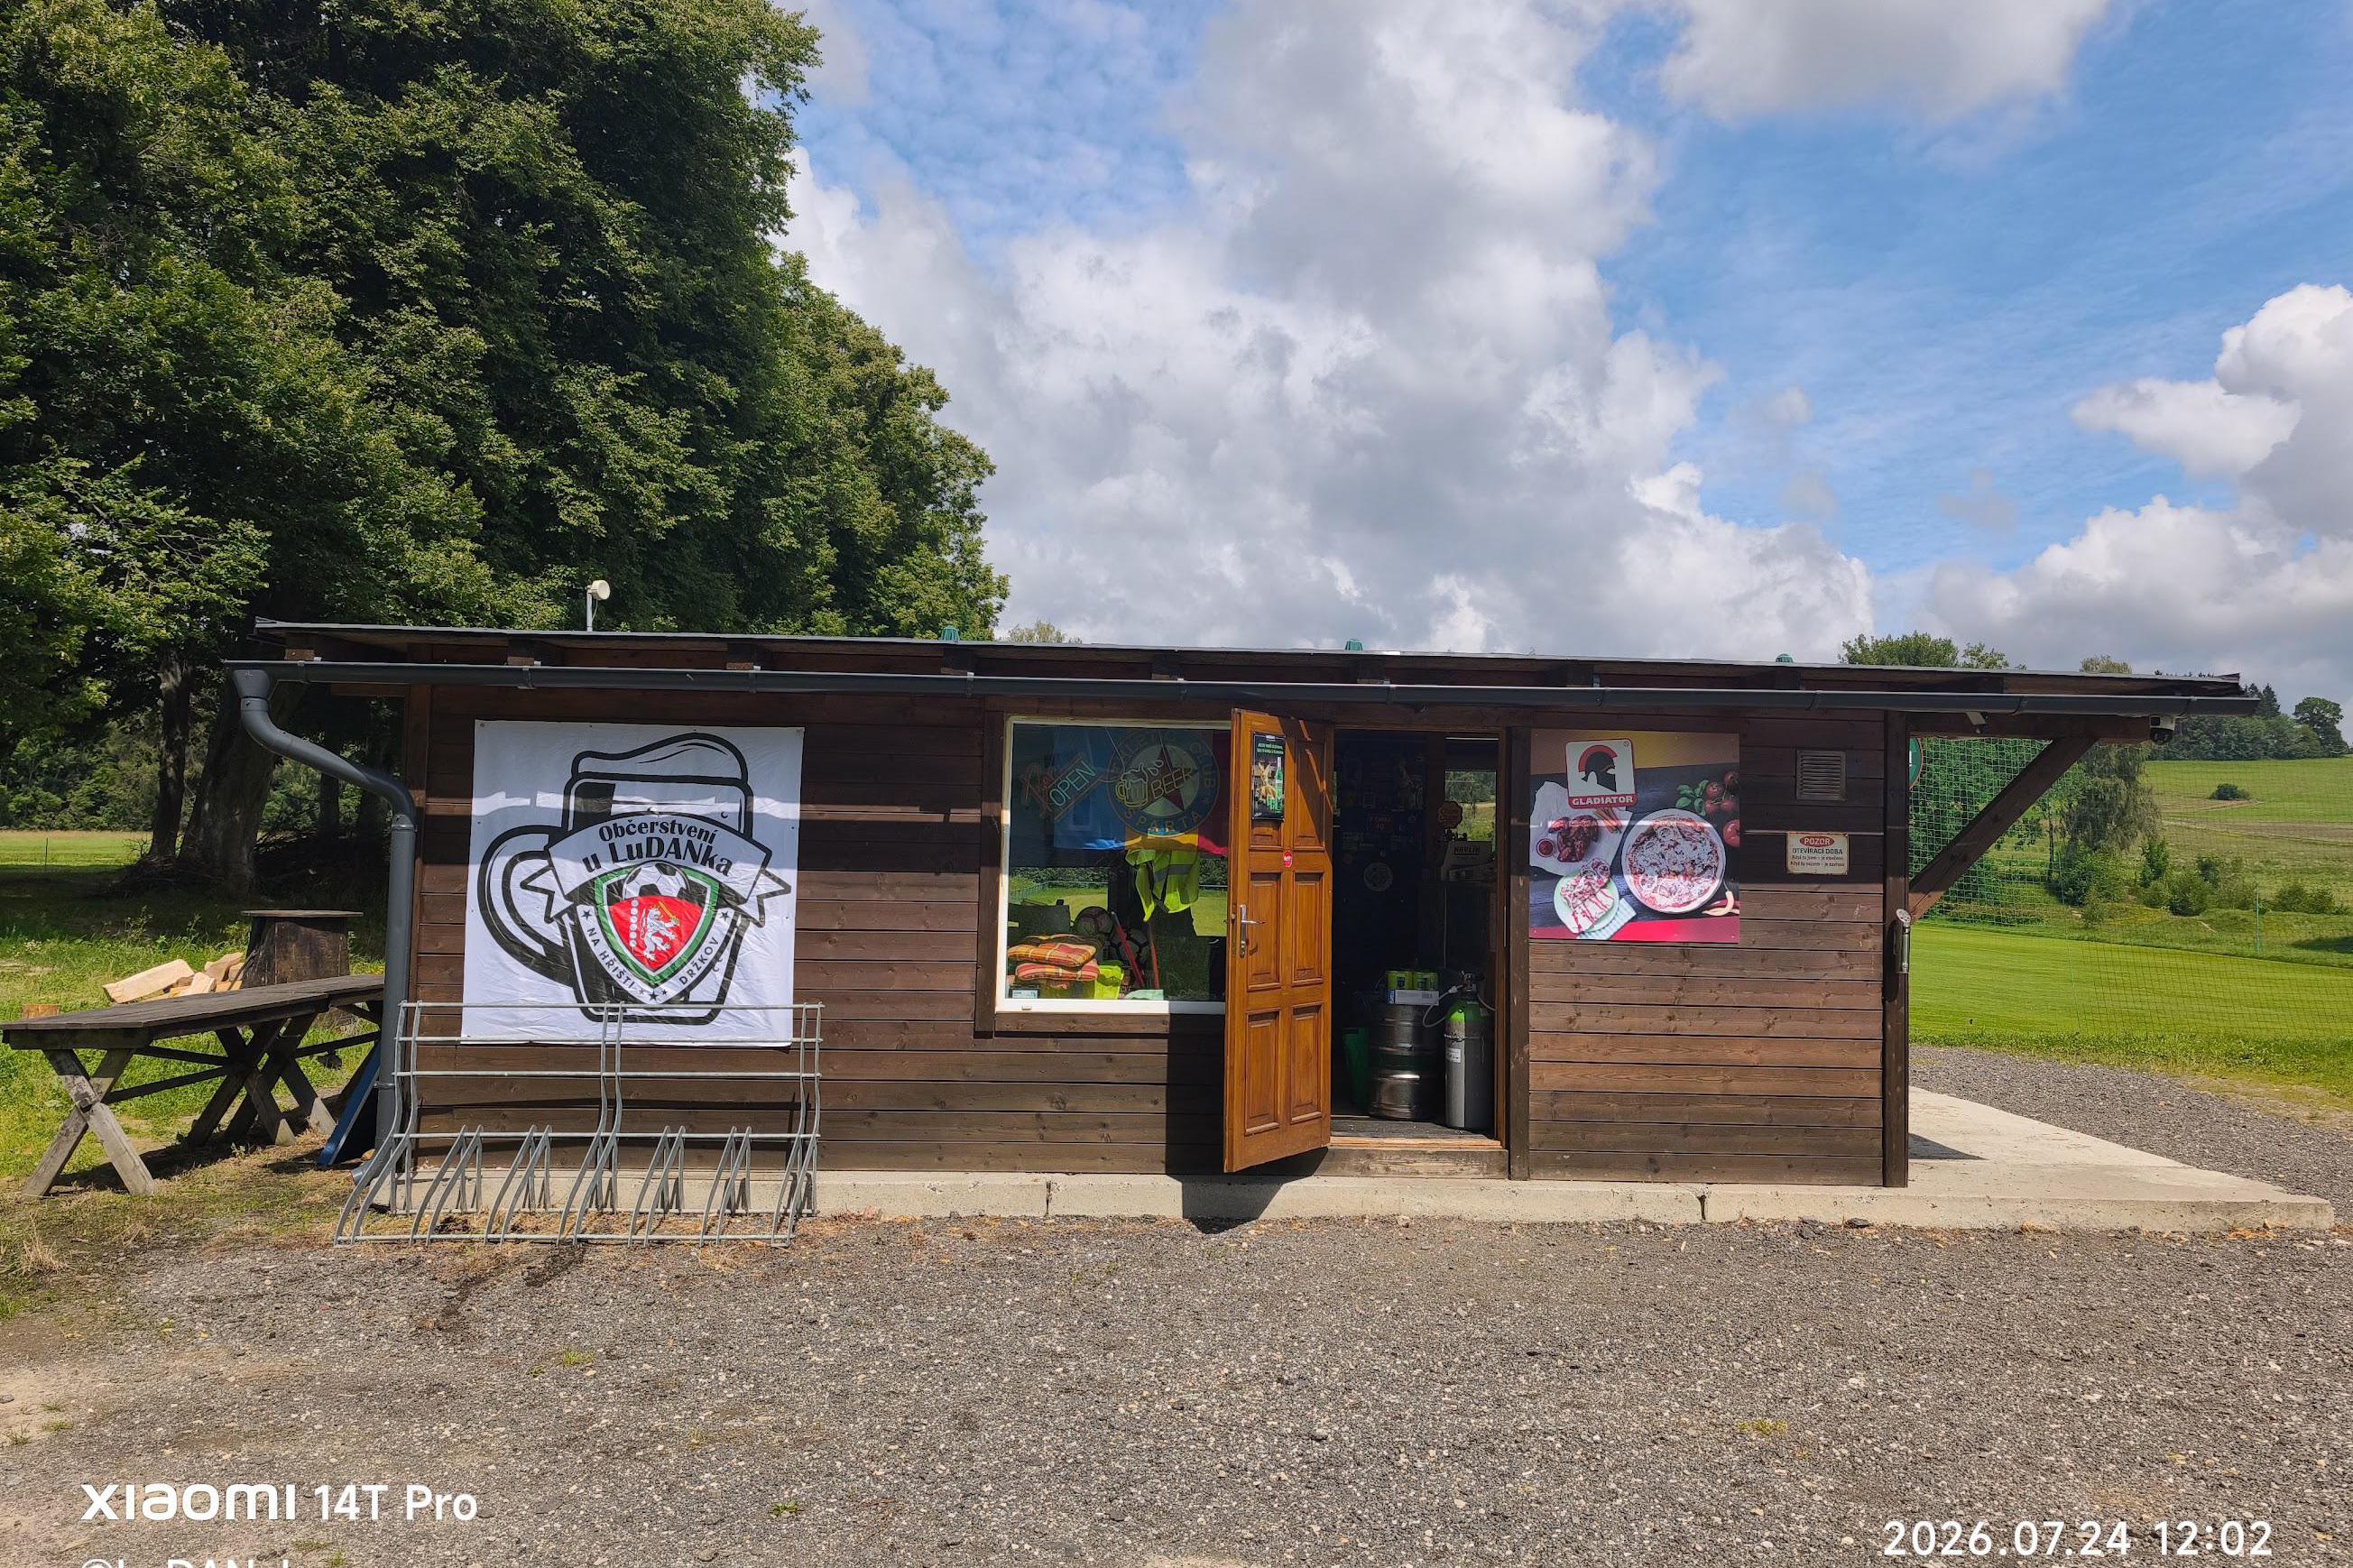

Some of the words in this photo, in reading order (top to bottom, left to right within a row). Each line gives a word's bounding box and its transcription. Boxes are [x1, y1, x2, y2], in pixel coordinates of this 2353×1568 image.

[1049, 761, 1096, 807] OPEN
[1150, 767, 1193, 799] BEER
[1573, 795, 1634, 805] GLADIATOR
[599, 818, 718, 844] Občerstvení
[583, 853, 601, 873] u
[609, 837, 733, 877] LuDANka
[587, 928, 601, 947] NA
[599, 949, 637, 991] HŘIŠTI
[678, 936, 719, 987] DRŽKOV
